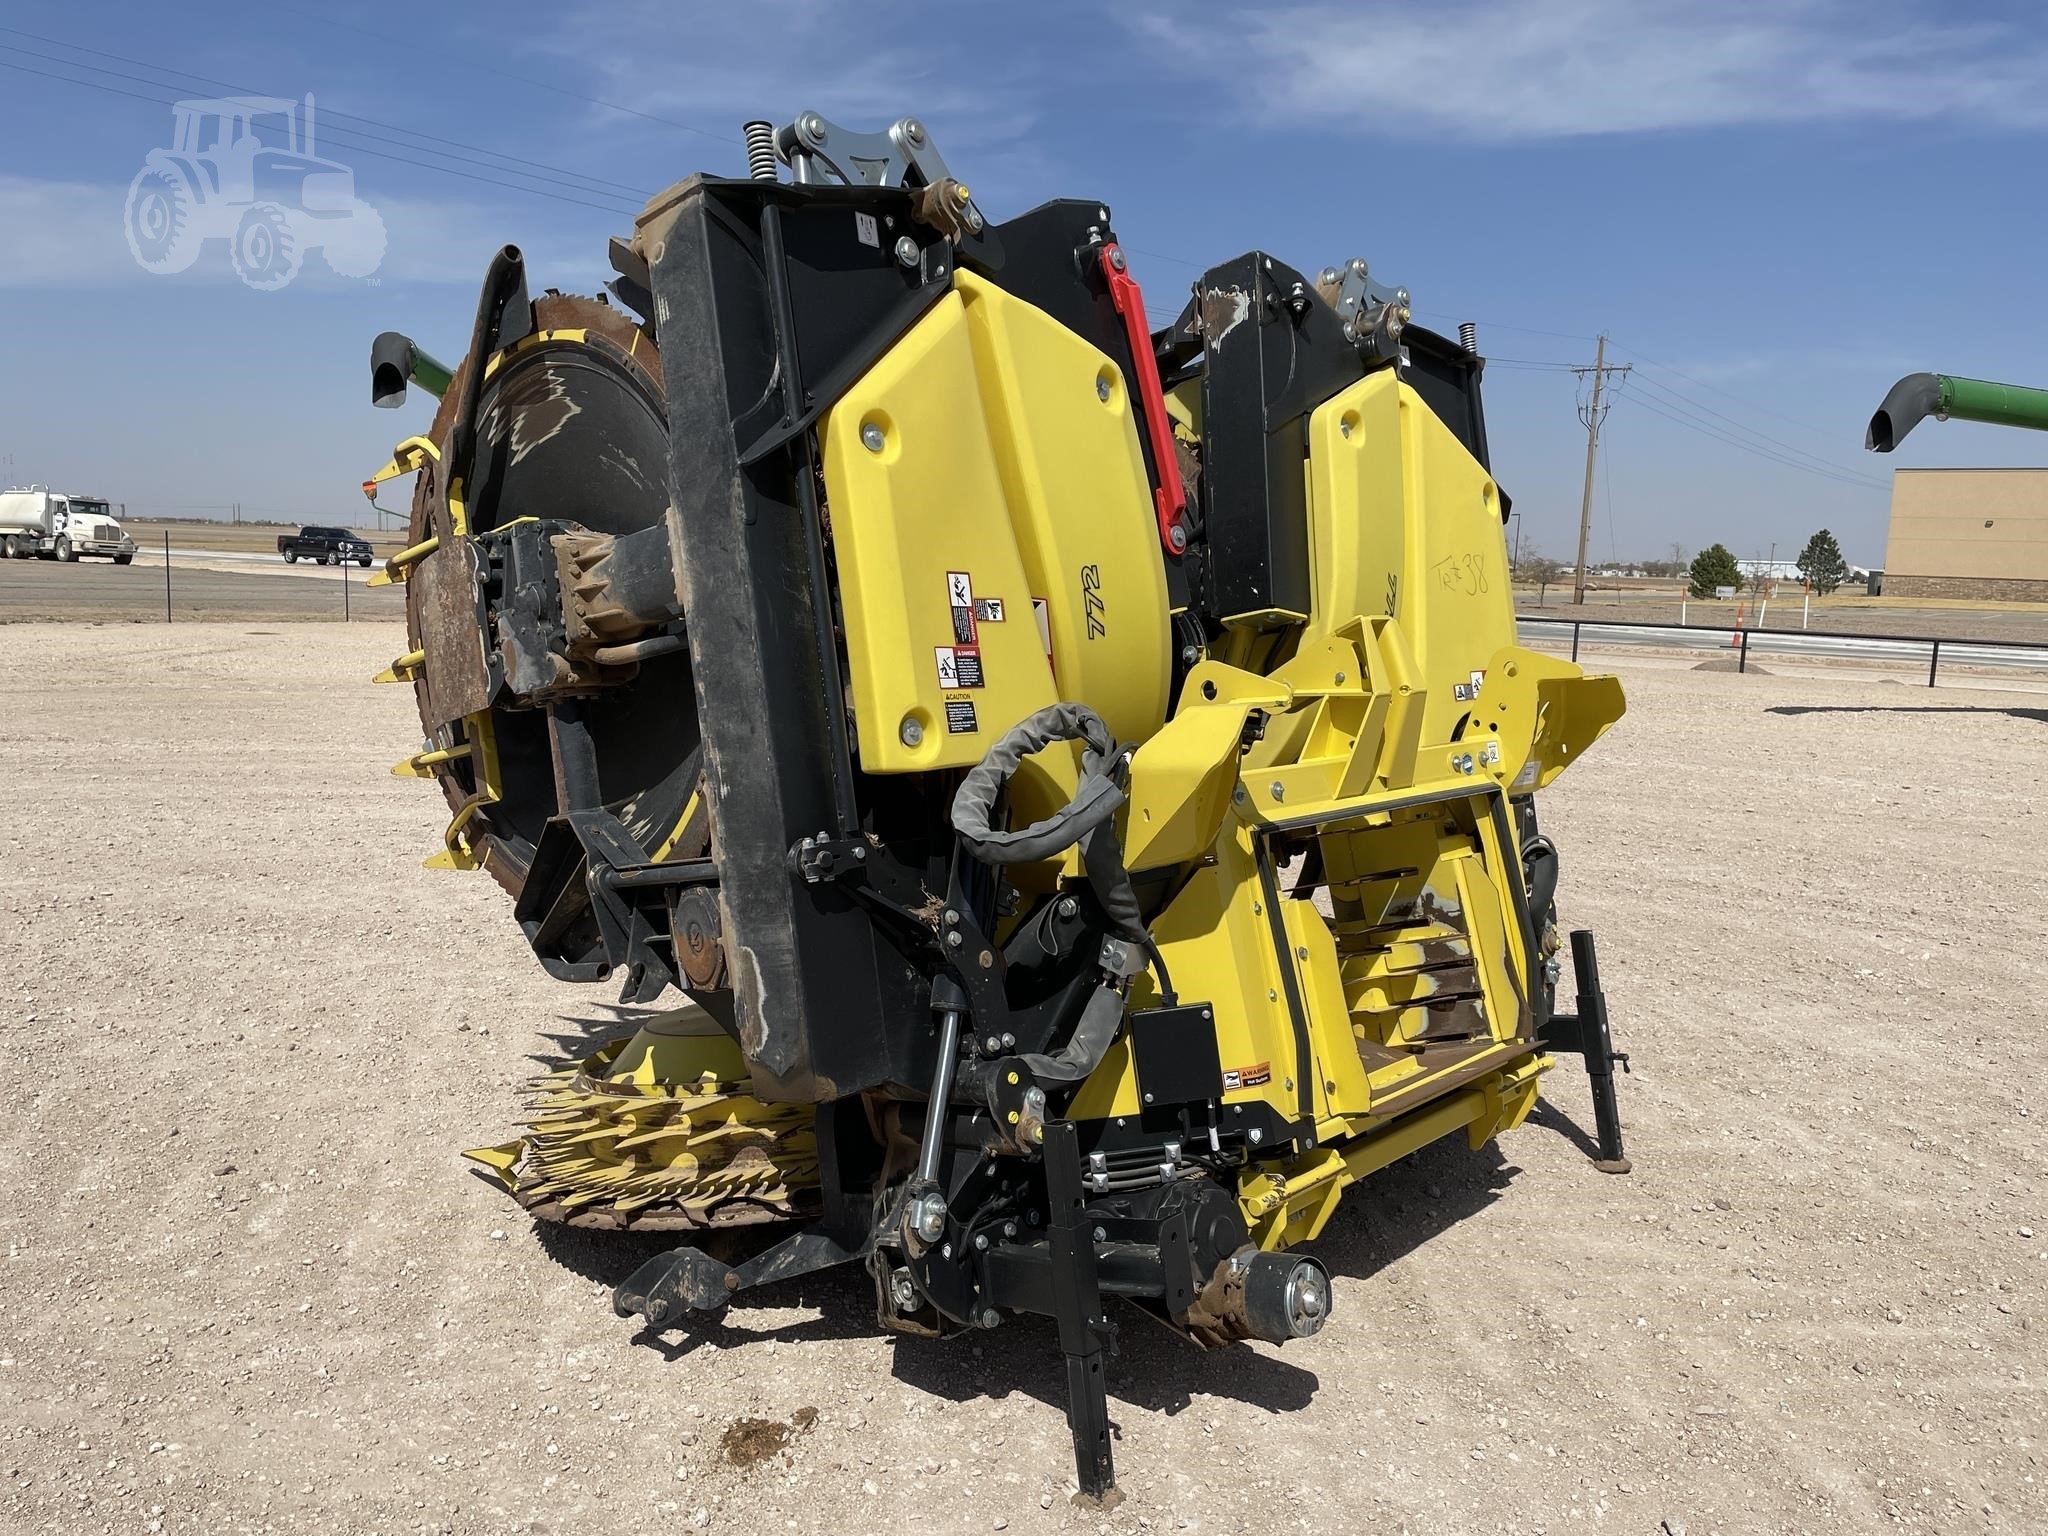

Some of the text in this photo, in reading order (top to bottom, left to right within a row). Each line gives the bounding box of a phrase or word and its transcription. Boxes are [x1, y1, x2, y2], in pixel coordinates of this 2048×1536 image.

[1081, 565, 1105, 640] 772
[1385, 572, 1397, 618] 77
[950, 693, 971, 701] CAUTION
